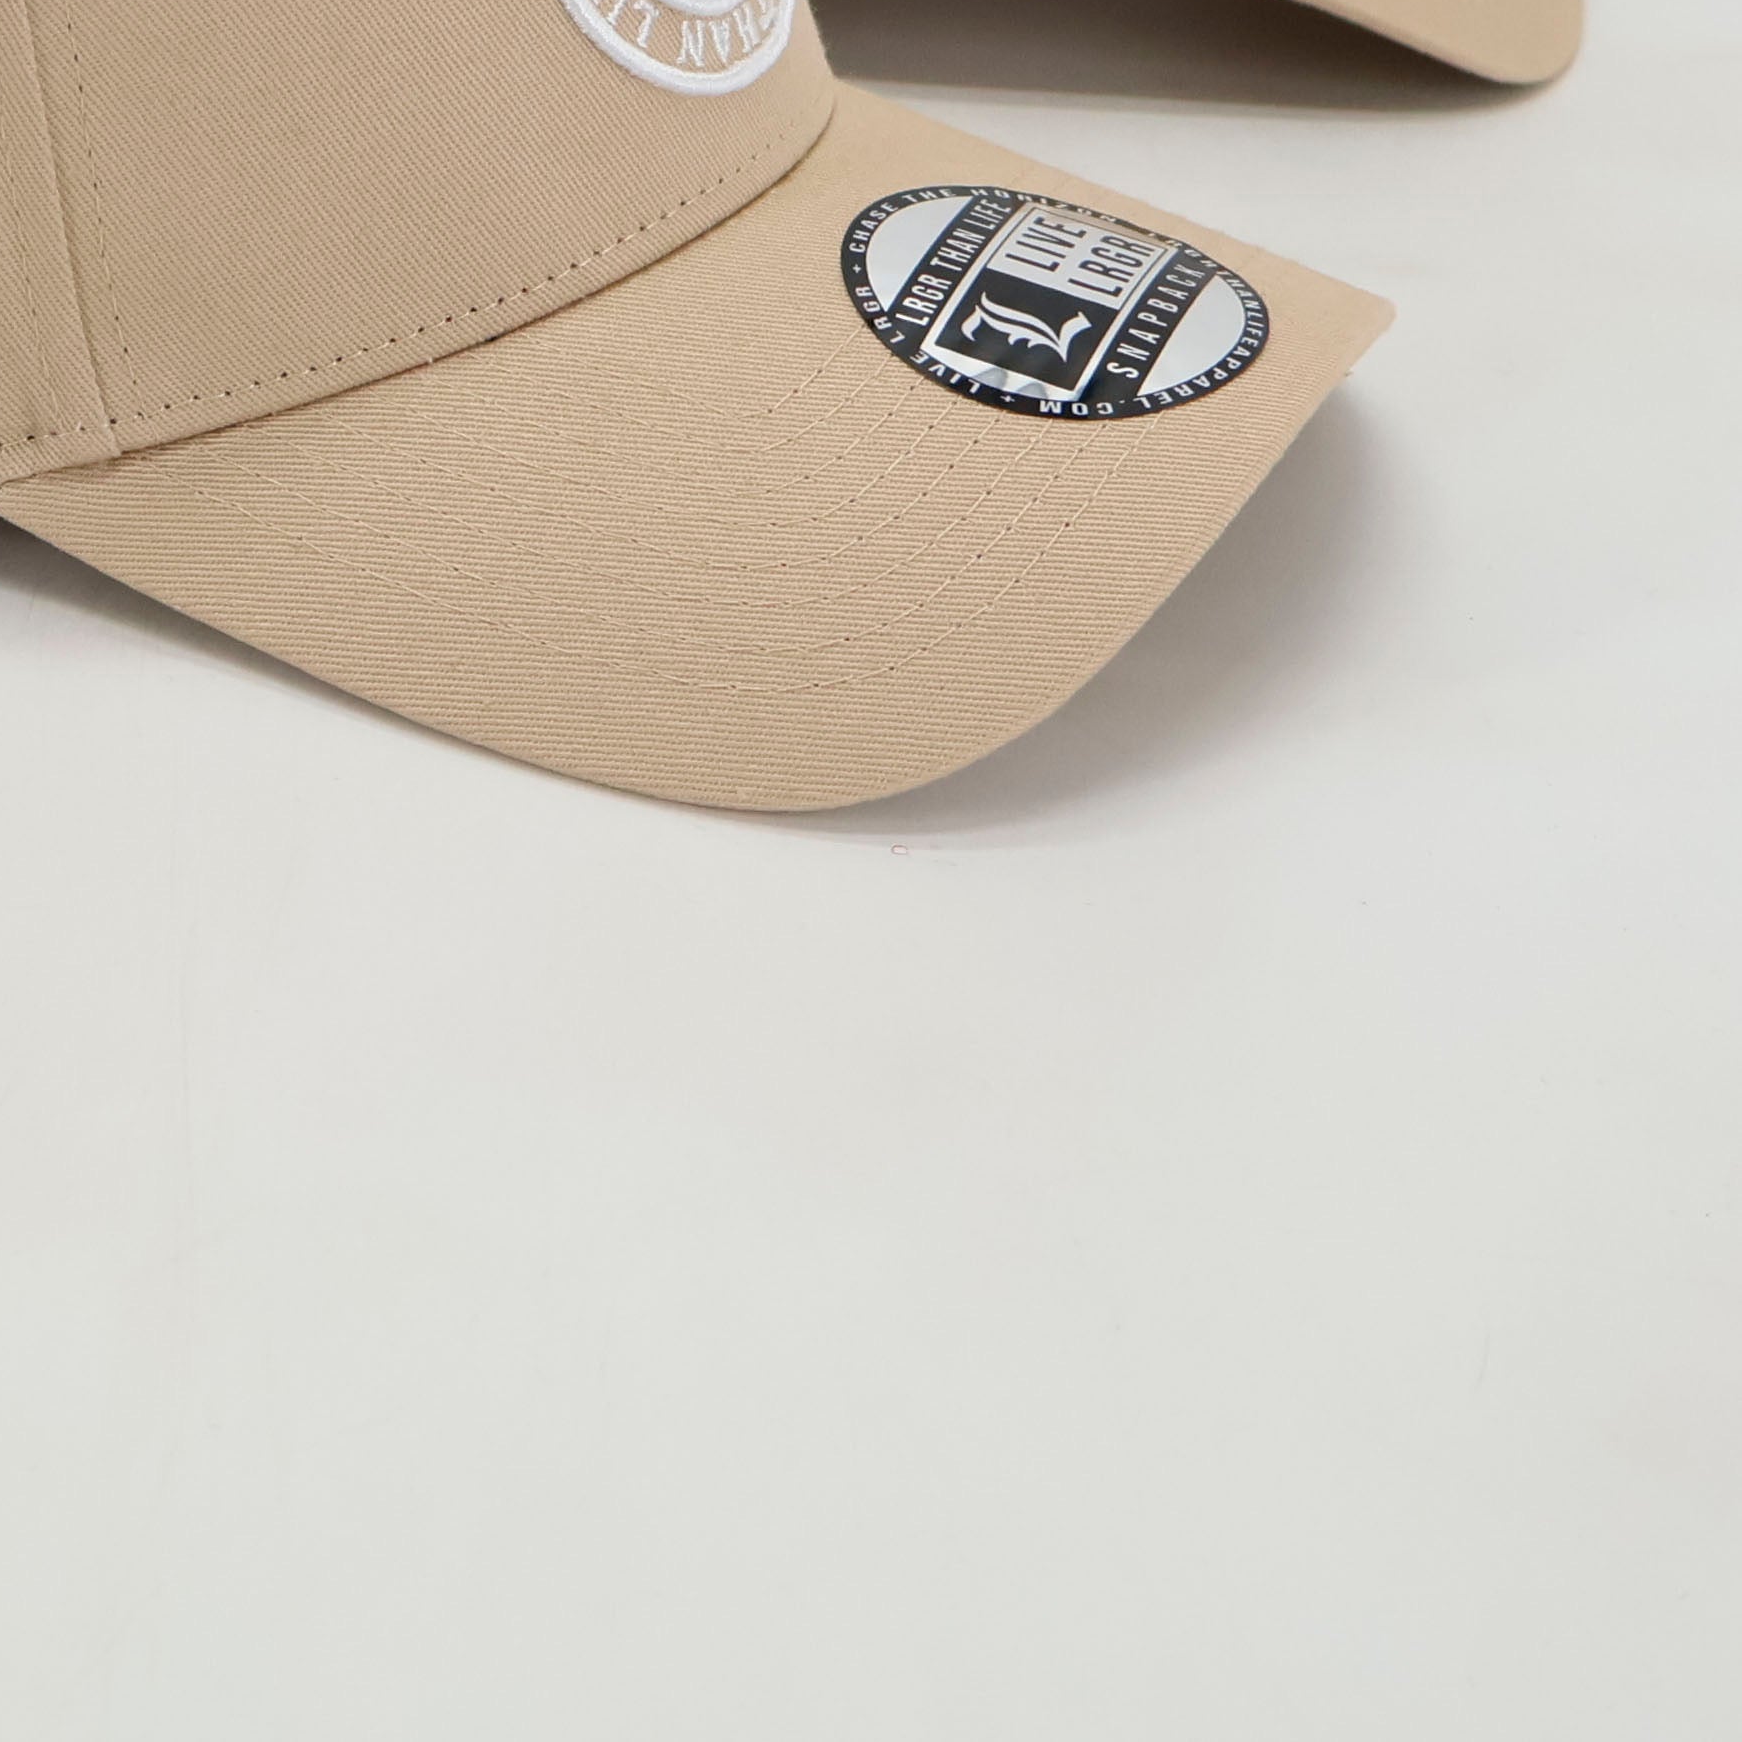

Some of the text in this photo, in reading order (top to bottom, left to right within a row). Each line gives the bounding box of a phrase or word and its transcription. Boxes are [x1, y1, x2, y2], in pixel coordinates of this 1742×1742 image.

[849, 201, 898, 254] CHASE
[902, 187, 956, 203] THE
[895, 198, 1012, 327] LRGR THAN LIFE
[1005, 215, 1087, 272] LIVE
[1068, 235, 1155, 297] LRGR
[855, 285, 981, 395] LIVE LRGR
[1106, 263, 1205, 379] SNAPBACK
